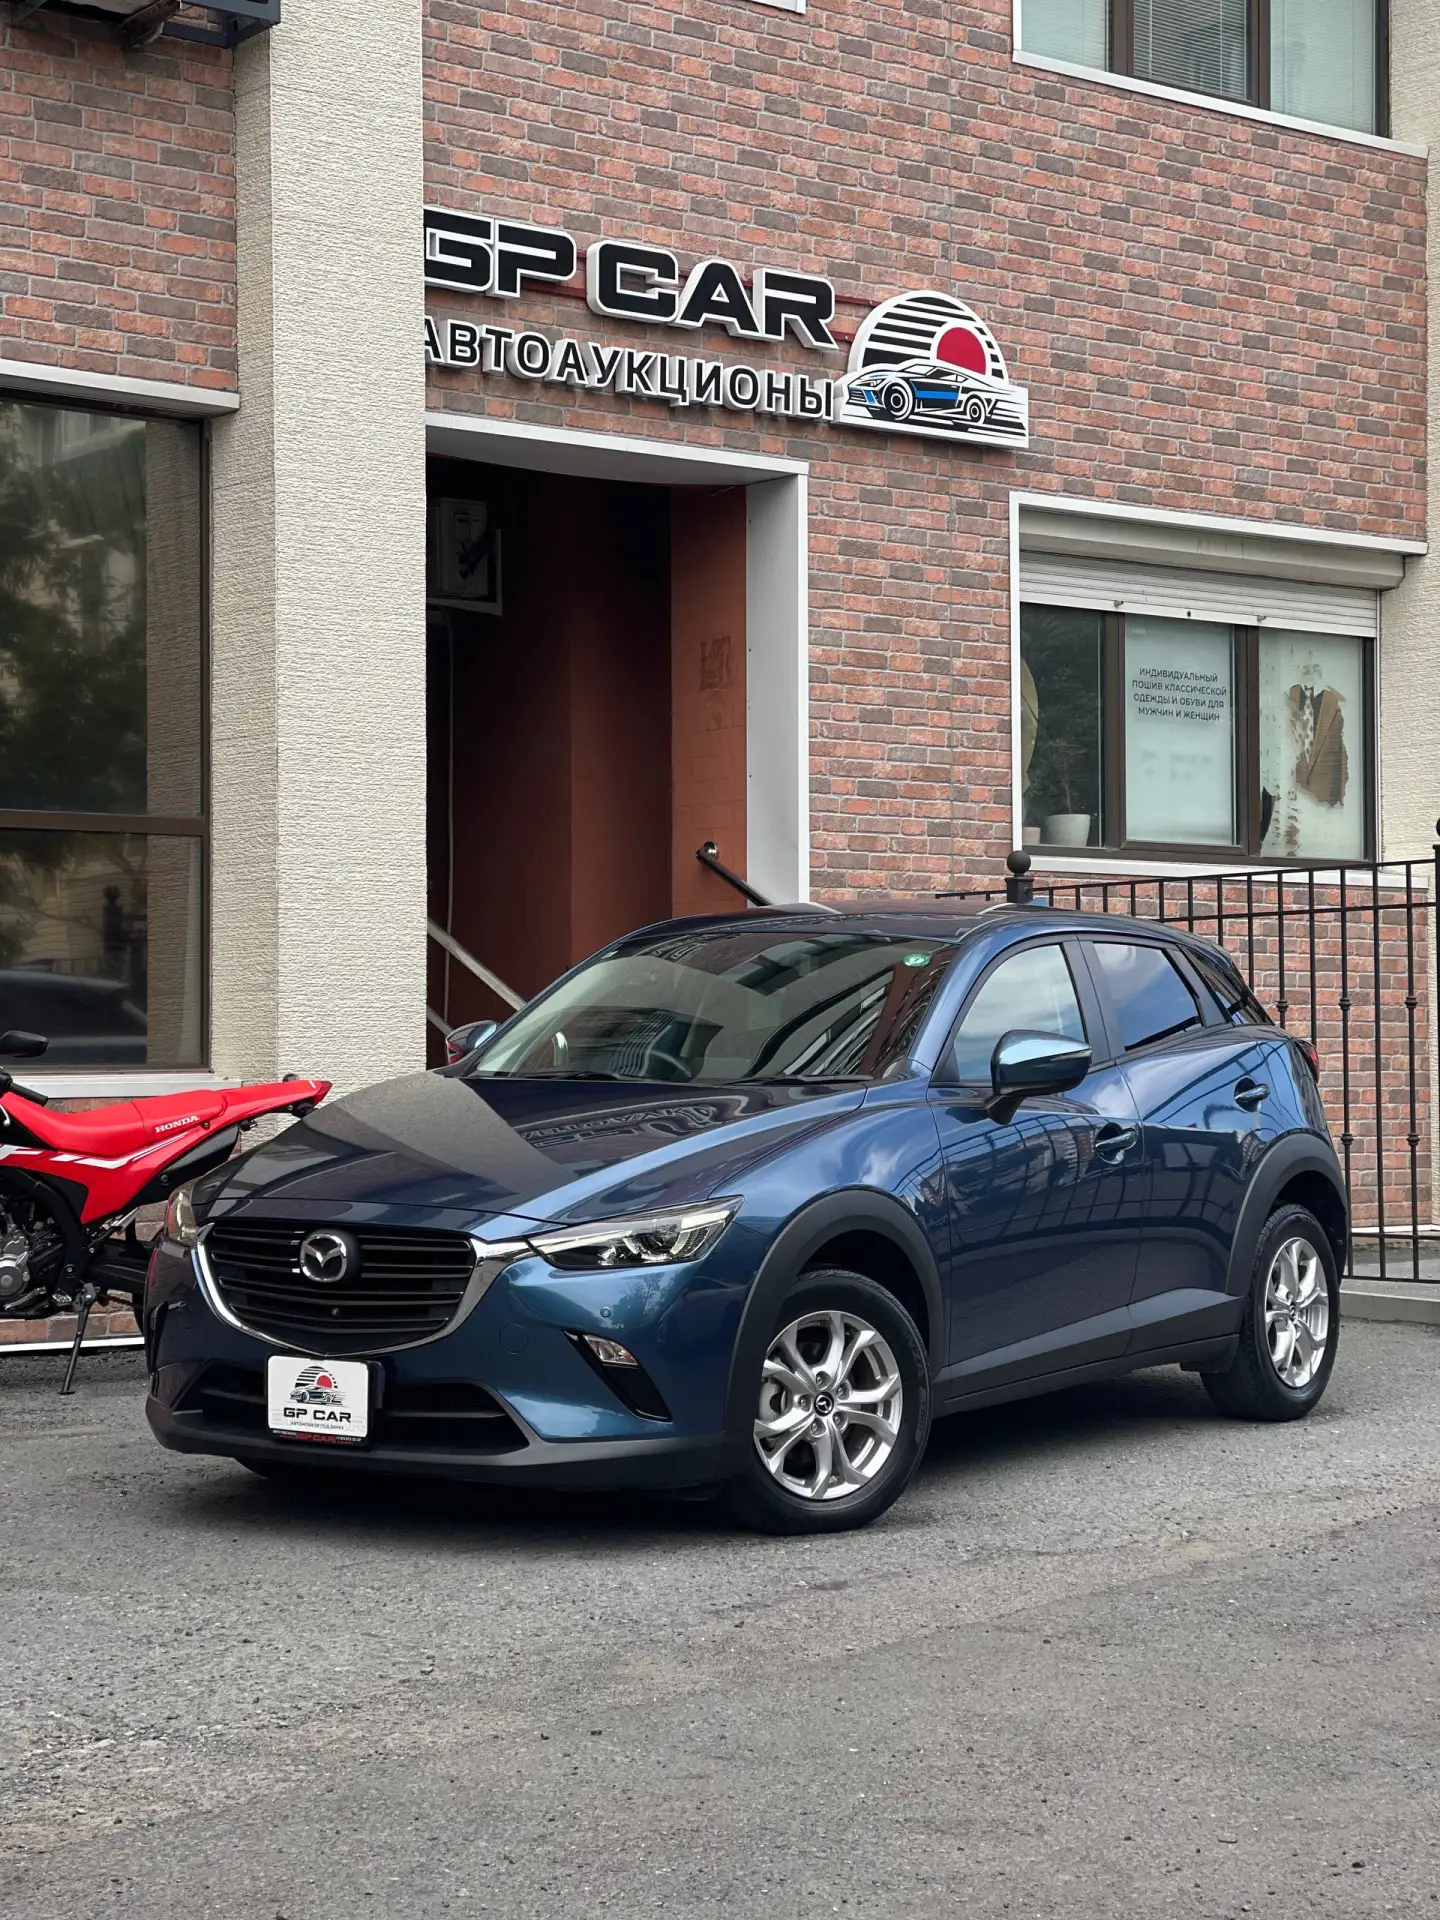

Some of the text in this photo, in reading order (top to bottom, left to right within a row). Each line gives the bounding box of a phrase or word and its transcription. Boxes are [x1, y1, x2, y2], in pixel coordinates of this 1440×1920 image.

[424, 206, 838, 350] GP CAR
[425, 315, 833, 421] АВТОАУКЦИОНЫ
[1139, 667, 1218, 683] ИНДИВИДУАЛЬНЫЙ
[1132, 679, 1227, 696] ПОШИВ КЛАССИЧЕСКОЙ
[1133, 693, 1224, 709] ОДЕЖДЫ И ОБУВИ ДЛЯ
[1138, 706, 1220, 721] МУЖЧИН И ЖЕНЩИН
[154, 1115, 199, 1133] HONDA
[283, 1407, 308, 1418] GP
[313, 1409, 352, 1423] CAR
